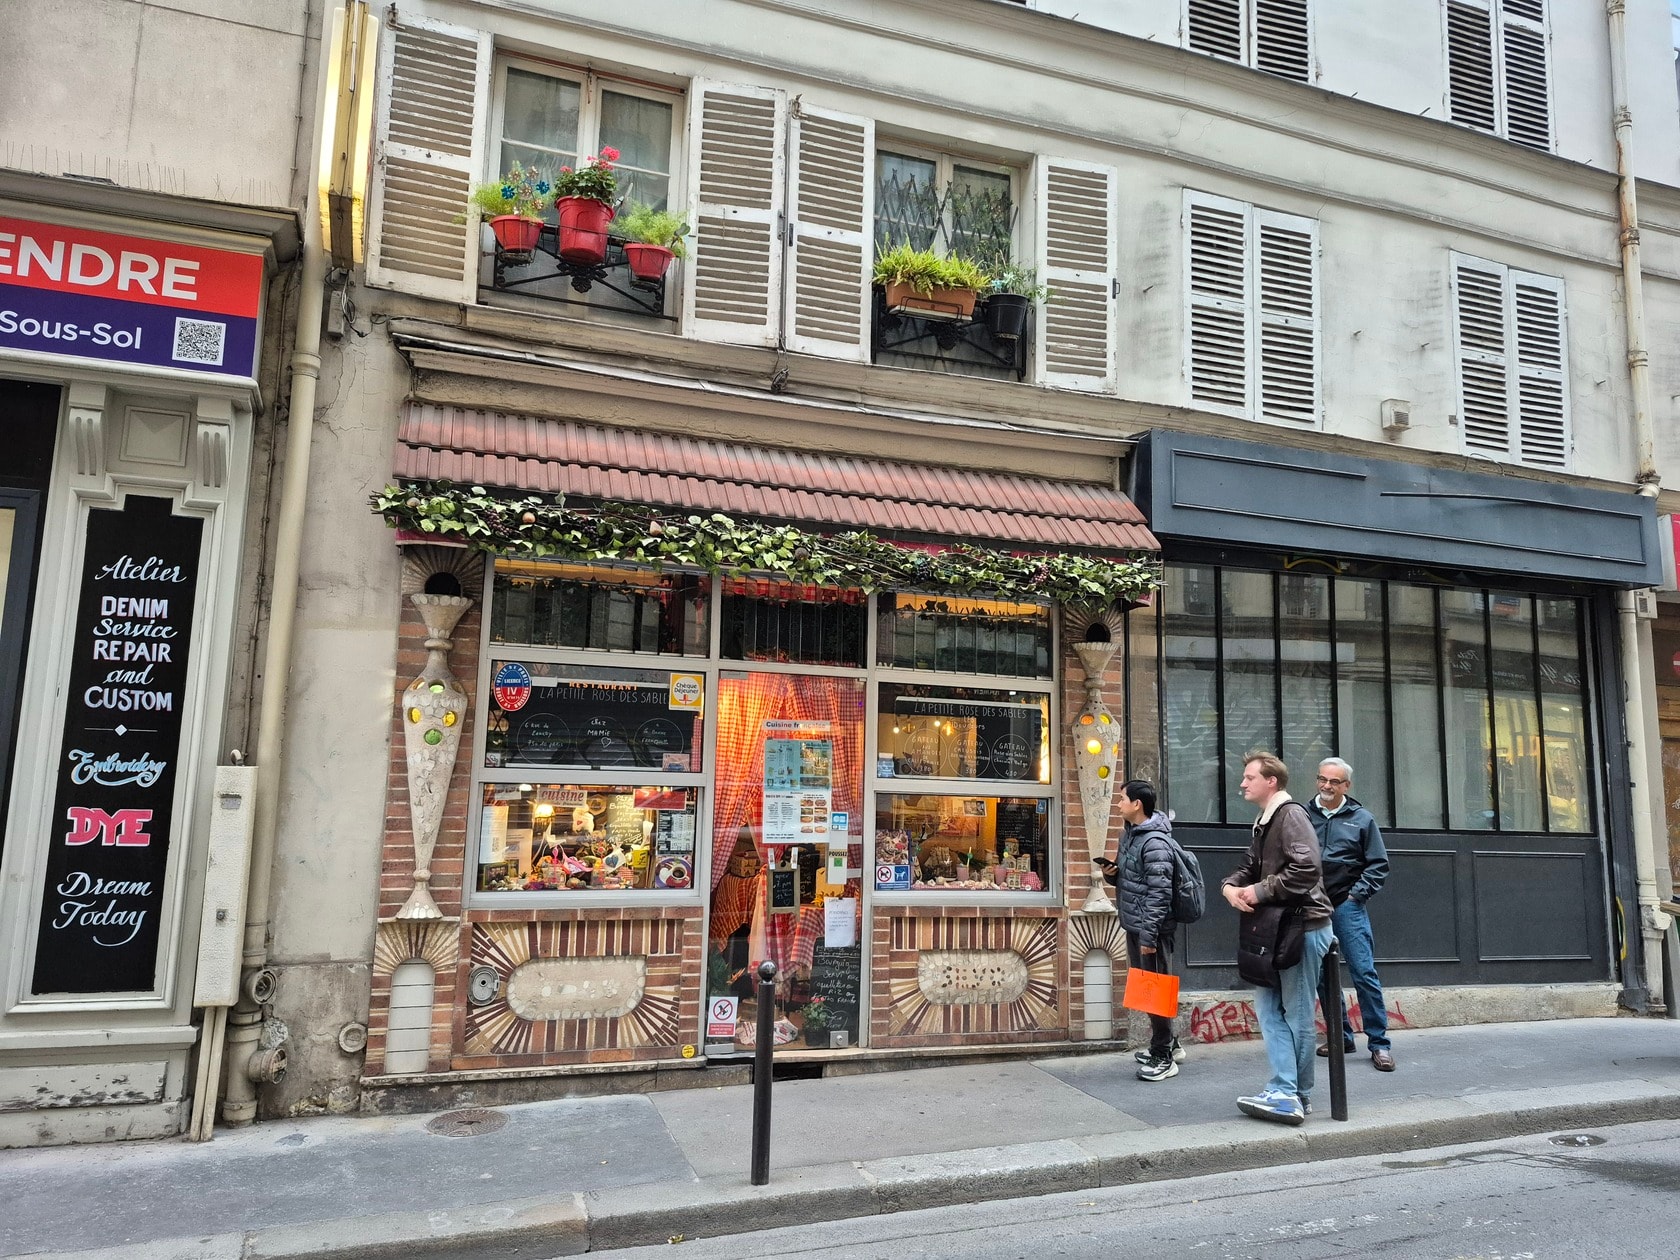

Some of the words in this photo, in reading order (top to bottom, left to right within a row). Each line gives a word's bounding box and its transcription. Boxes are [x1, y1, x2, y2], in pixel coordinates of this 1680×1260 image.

[0, 310, 142, 349] Sous-Sol
[95, 555, 187, 582] Atelier
[101, 596, 168, 619] DENIM
[93, 618, 178, 639] Service
[93, 640, 172, 663] REPAIR
[103, 664, 154, 685] and
[568, 681, 638, 691] RESTAURANT
[675, 682, 698, 690] Chèque
[84, 686, 173, 711] CUSTOM
[507, 686, 518, 695] IV
[540, 687, 554, 699] LA
[556, 688, 585, 700] PETITE
[592, 689, 616, 702] ROSE
[620, 691, 638, 703] DES
[640, 692, 667, 705] SABLE
[914, 703, 926, 713] LA
[928, 703, 954, 715] PETITE
[960, 706, 979, 716] ROSE
[982, 707, 996, 717] DES
[998, 708, 1027, 719] SABLES
[68, 749, 167, 788] Embroidery
[541, 790, 584, 801] cuisine
[65, 807, 153, 847] DYE
[57, 871, 153, 897] Dream
[52, 899, 147, 947] Today
